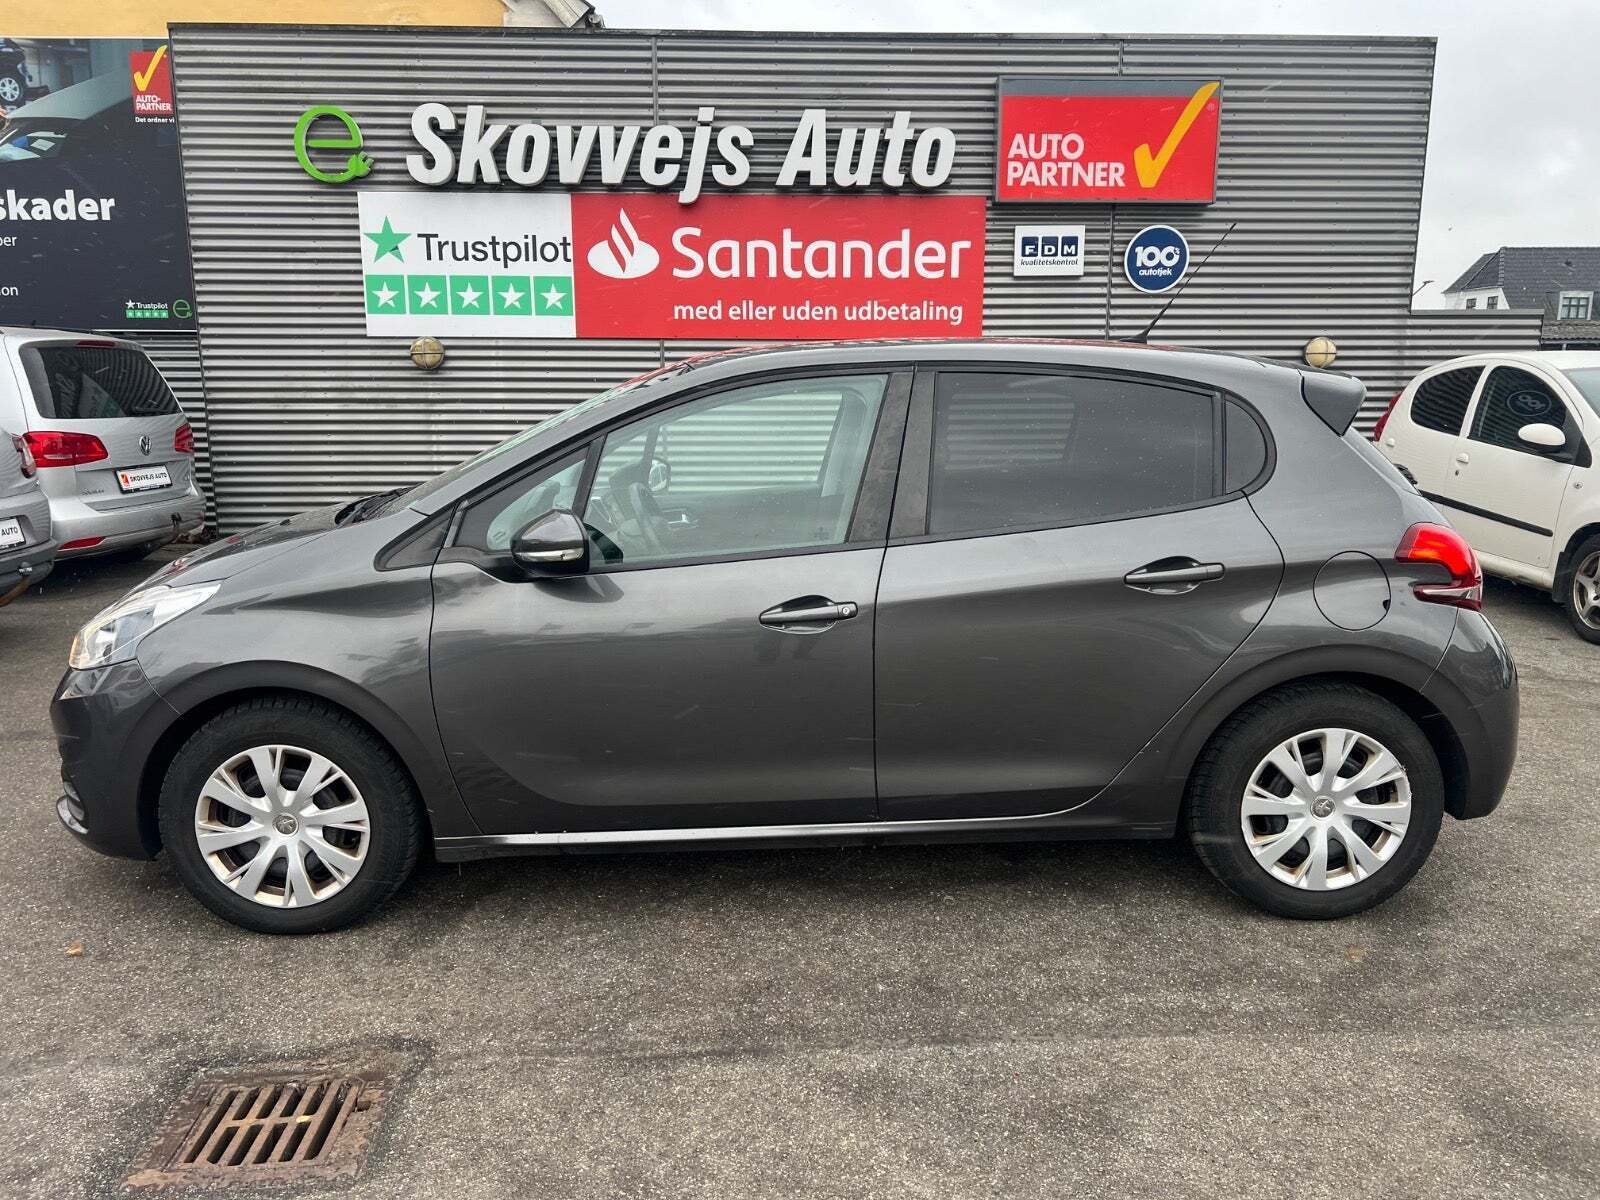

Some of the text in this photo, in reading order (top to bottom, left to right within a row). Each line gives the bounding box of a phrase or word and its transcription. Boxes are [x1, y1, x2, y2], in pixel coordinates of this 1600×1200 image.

[136, 102, 172, 111] PARTNER
[406, 102, 957, 204] Skovvejs Auto
[1007, 133, 1085, 160] AUTO
[1006, 161, 1126, 188] PARTNER
[417, 233, 572, 269] Trustpilot
[671, 226, 972, 280] Santander
[1023, 243, 1077, 257] FDM
[1020, 258, 1079, 267] kvalitetskontrol
[0, 286, 19, 296] on
[136, 302, 169, 311] Trustpilot
[673, 300, 963, 325] med eller uden udbetaling
[1, 526, 19, 536] AUTO
